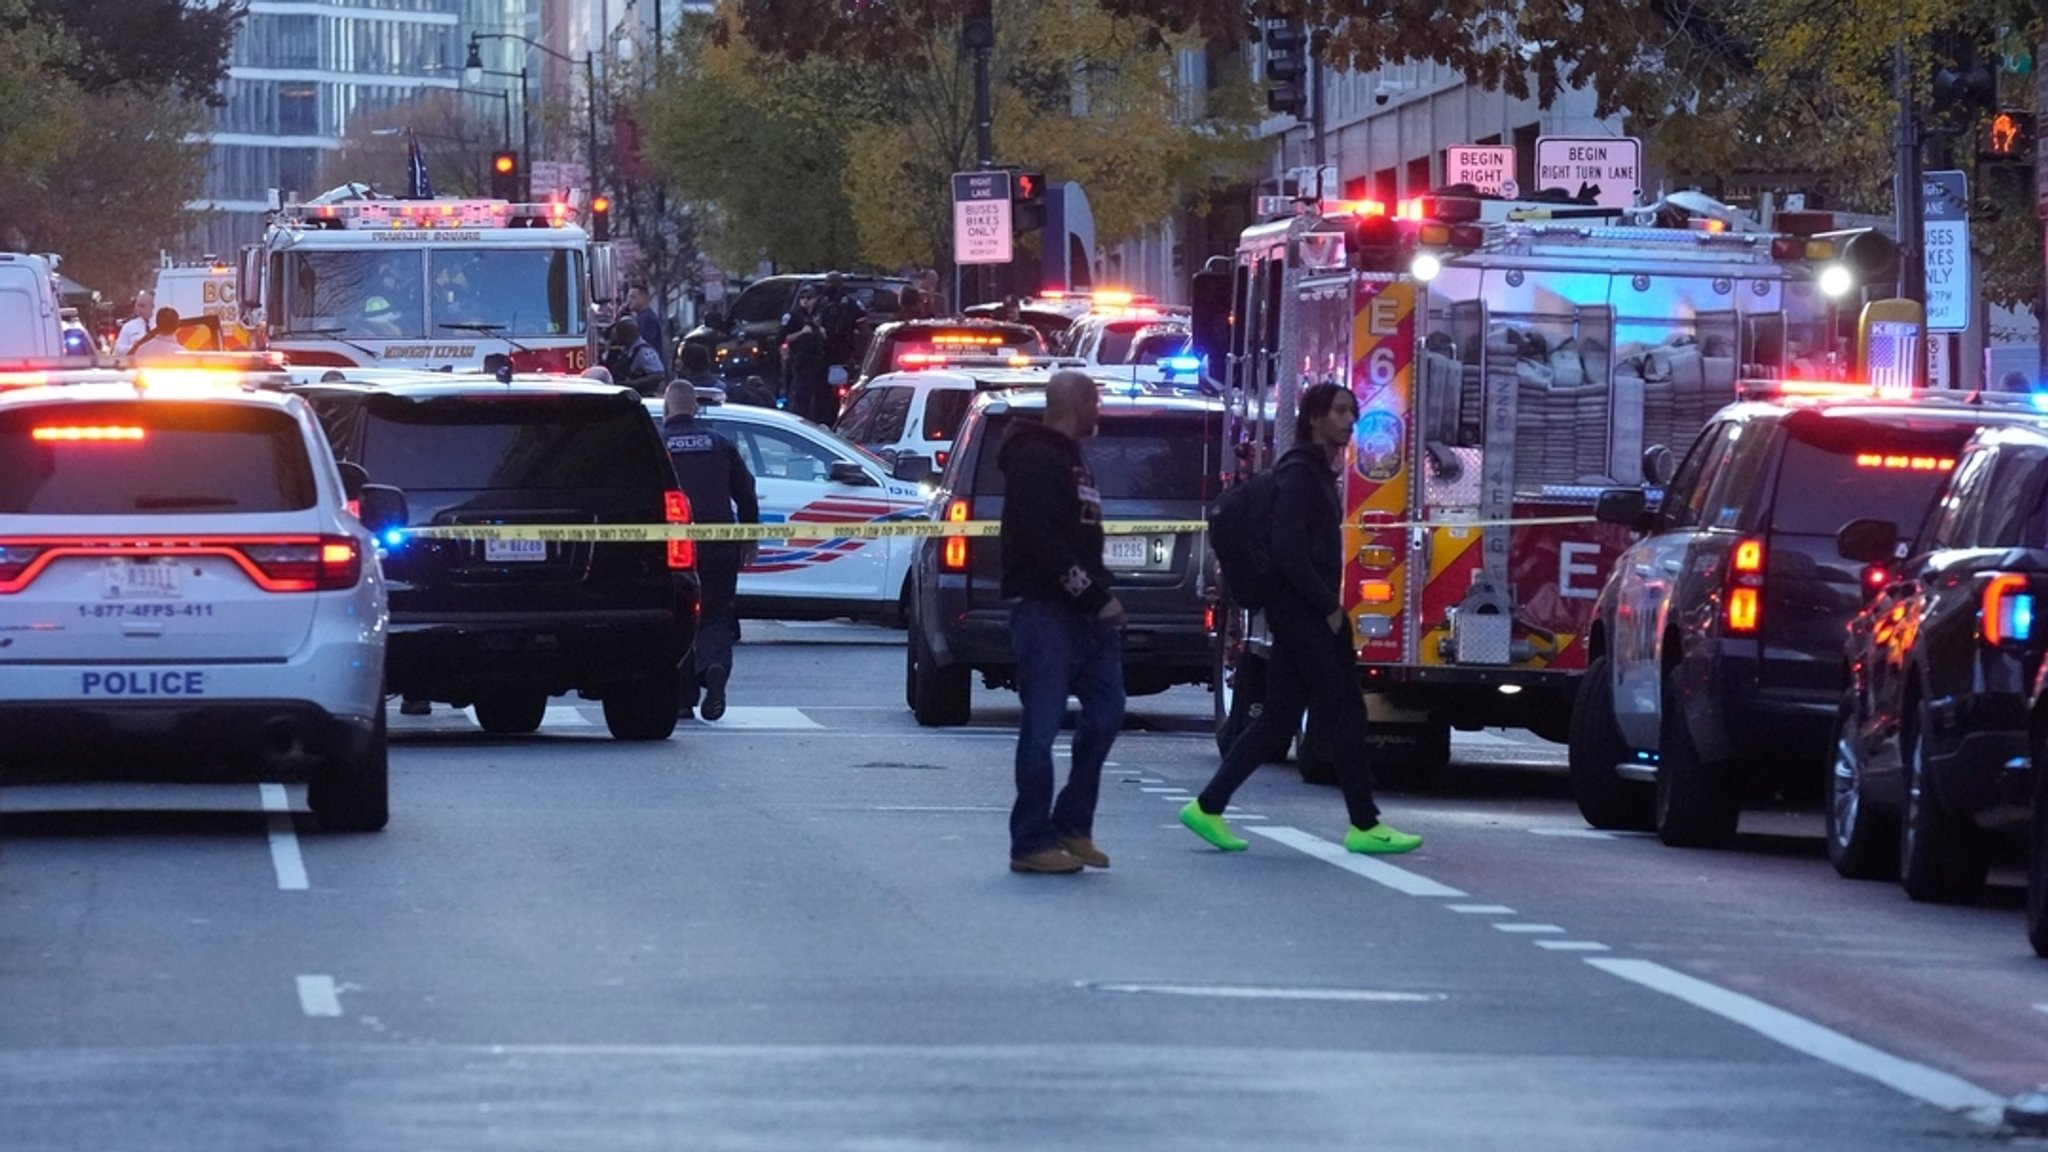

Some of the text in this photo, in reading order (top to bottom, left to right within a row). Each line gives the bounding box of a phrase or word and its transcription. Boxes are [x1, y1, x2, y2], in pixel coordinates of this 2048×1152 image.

[1461, 152, 1503, 166] BEGIN
[1569, 147, 1607, 161] BEGIN
[1461, 169, 1503, 182] RIGHT
[1541, 165, 1633, 179] RIGHT TURN LANE
[971, 188, 992, 198] LANE
[1922, 182, 1944, 195] IGHT
[965, 204, 999, 216] BUSES
[1924, 201, 1944, 214] ANE
[966, 217, 999, 227] BIKES
[968, 227, 998, 237] ONLY
[1928, 247, 1954, 265] KES
[1926, 268, 1953, 284] NLY
[564, 350, 586, 369] 16
[666, 438, 713, 449] POLICE
[600, 528, 617, 538] LINE
[619, 528, 648, 540] POLICE
[747, 527, 765, 538] LINE
[767, 526, 796, 538] POLICE
[895, 526, 913, 537] LINE
[915, 525, 944, 536] POLICE
[1559, 541, 1601, 599] E
[78, 604, 213, 618] 1-877-4FPS-411
[82, 672, 204, 694] POLICE
